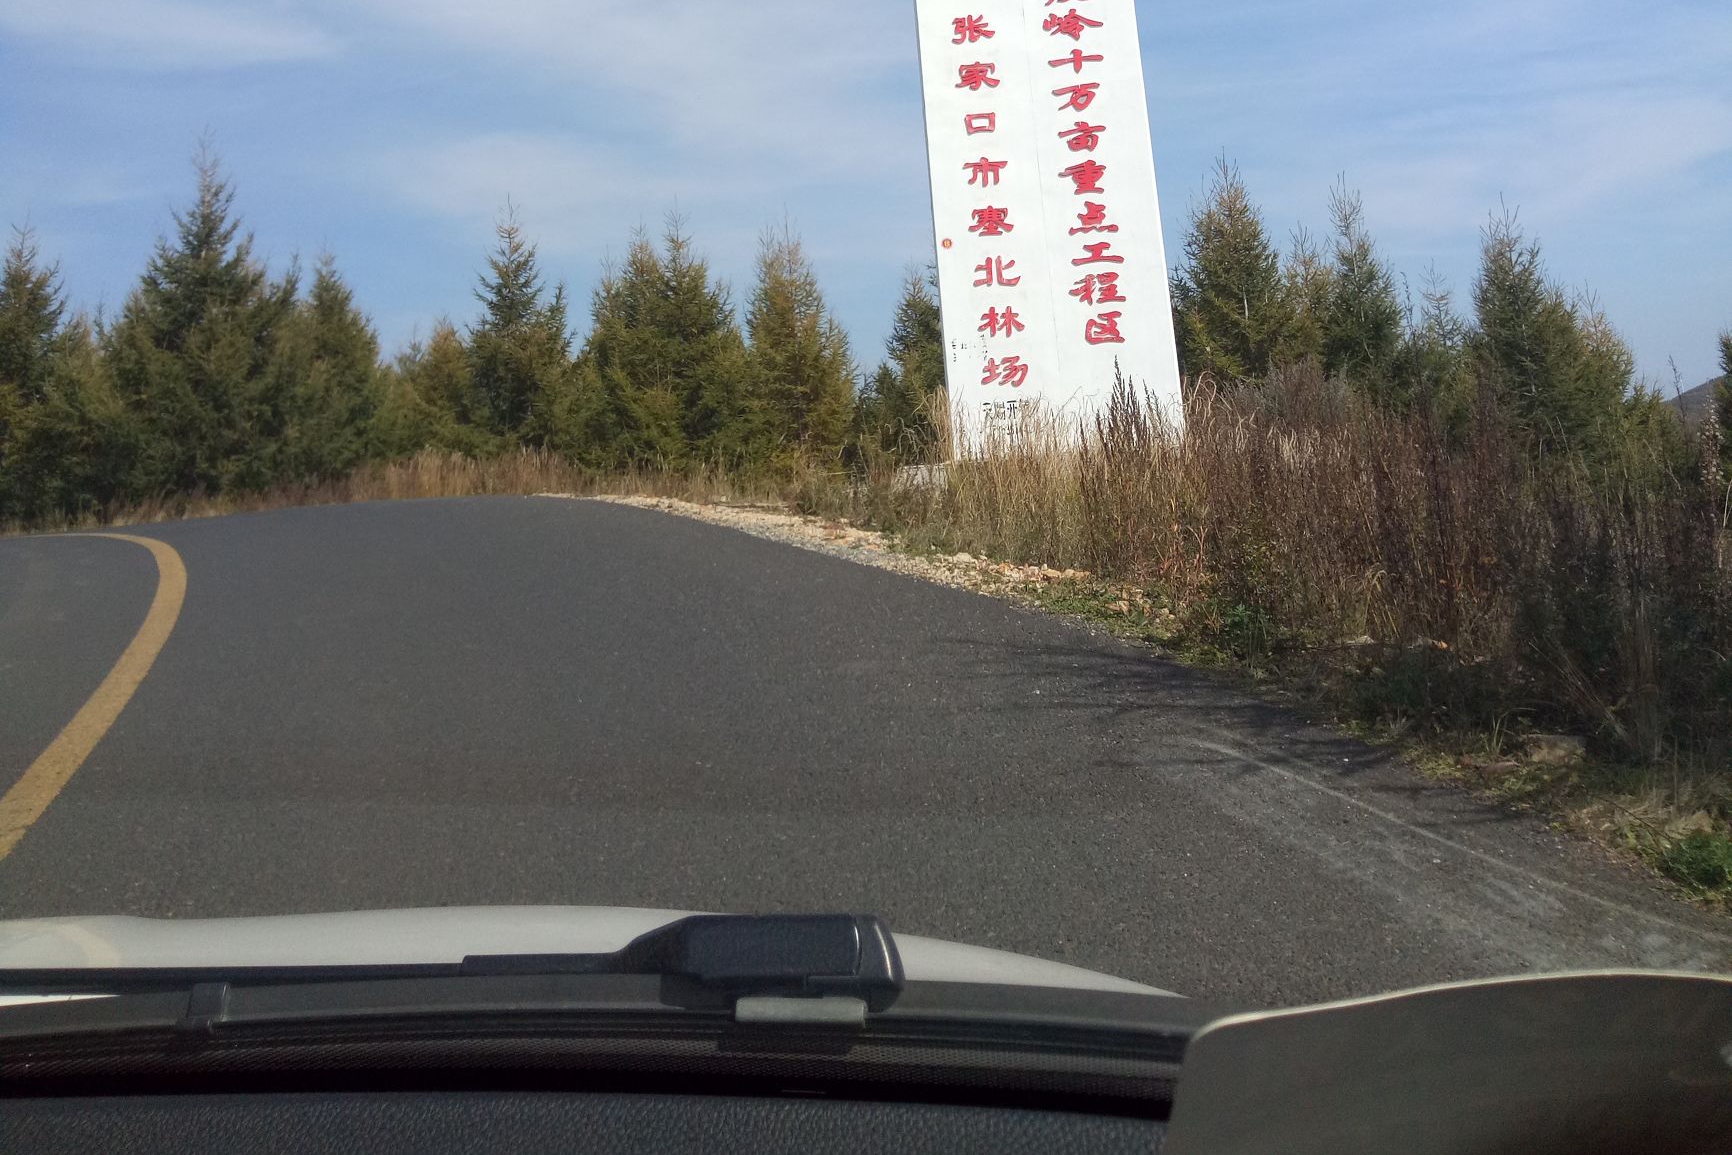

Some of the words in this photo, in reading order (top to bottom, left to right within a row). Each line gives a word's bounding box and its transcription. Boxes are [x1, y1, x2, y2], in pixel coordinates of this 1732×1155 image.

[952, 14, 1029, 387] 张家口市塞北林场
